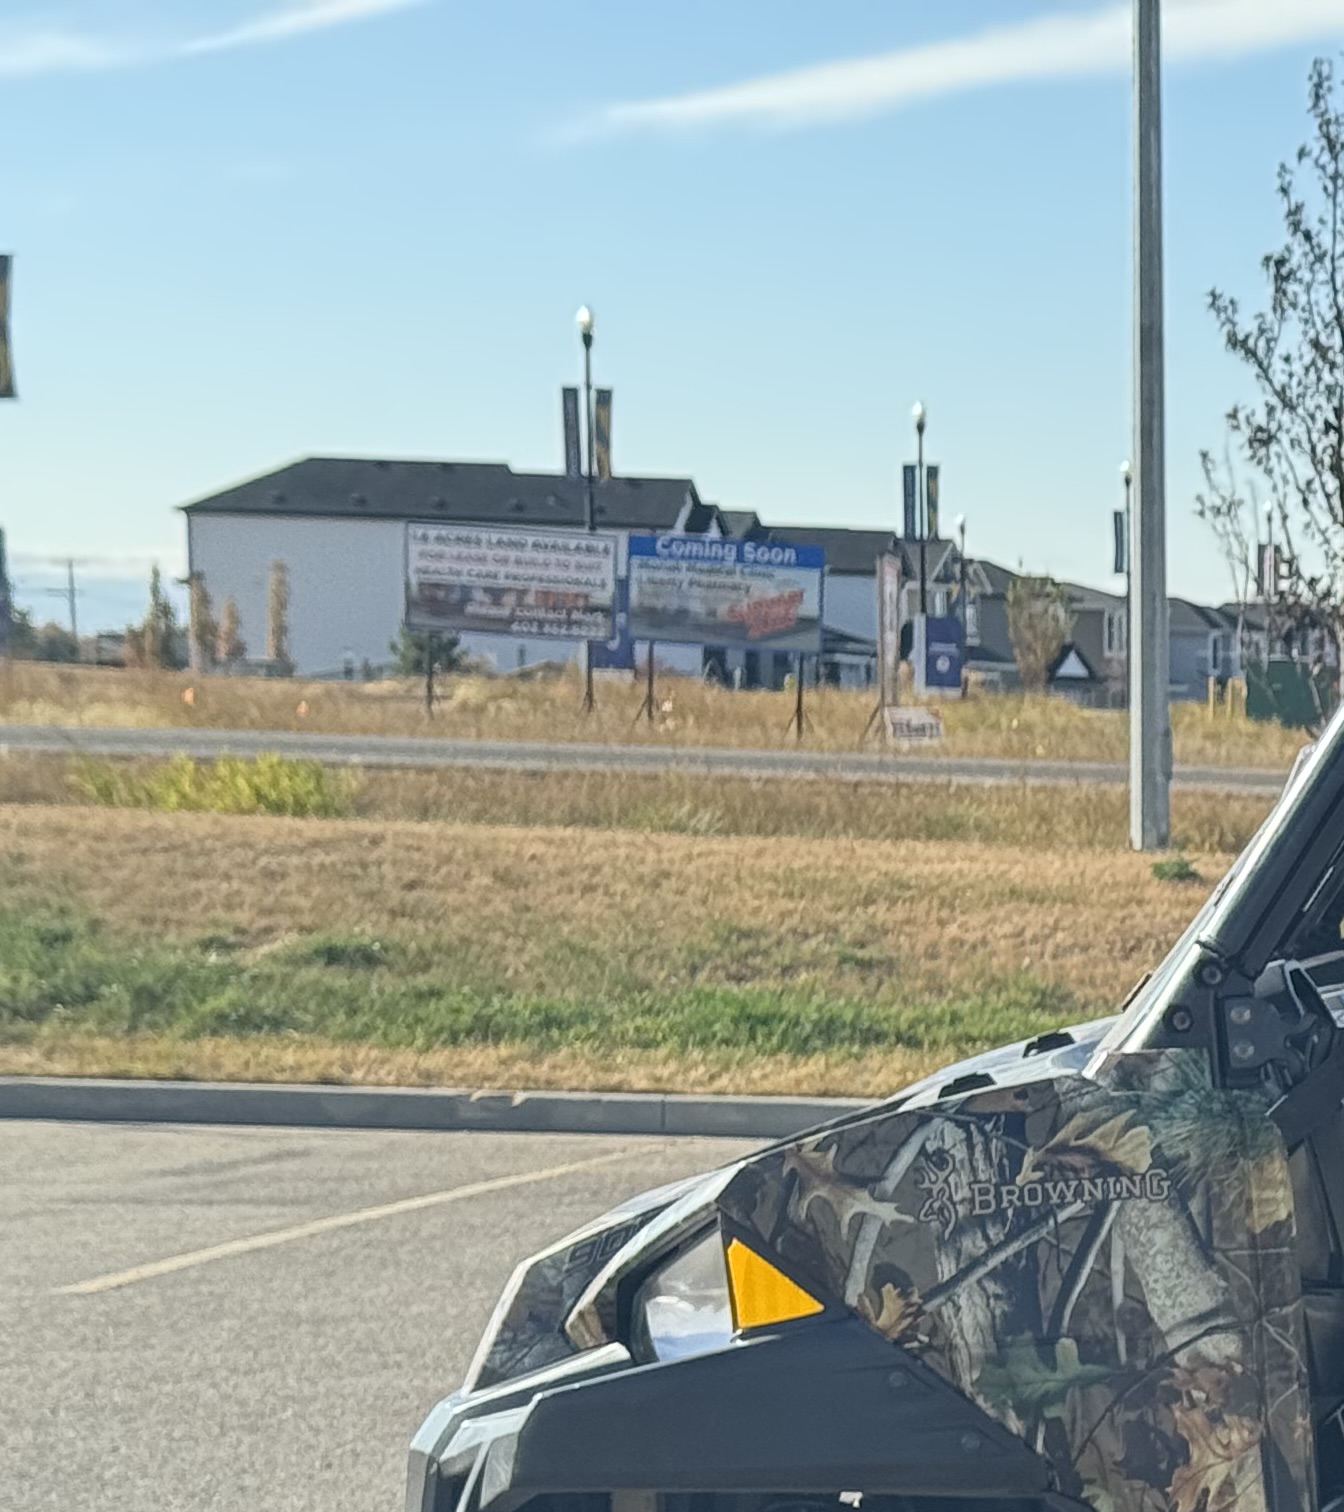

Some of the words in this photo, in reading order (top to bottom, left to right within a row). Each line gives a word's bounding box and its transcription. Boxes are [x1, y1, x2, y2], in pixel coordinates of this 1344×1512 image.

[655, 535, 738, 565] Coming
[743, 541, 798, 565] Soon
[971, 1168, 1172, 1216] BROWNING
